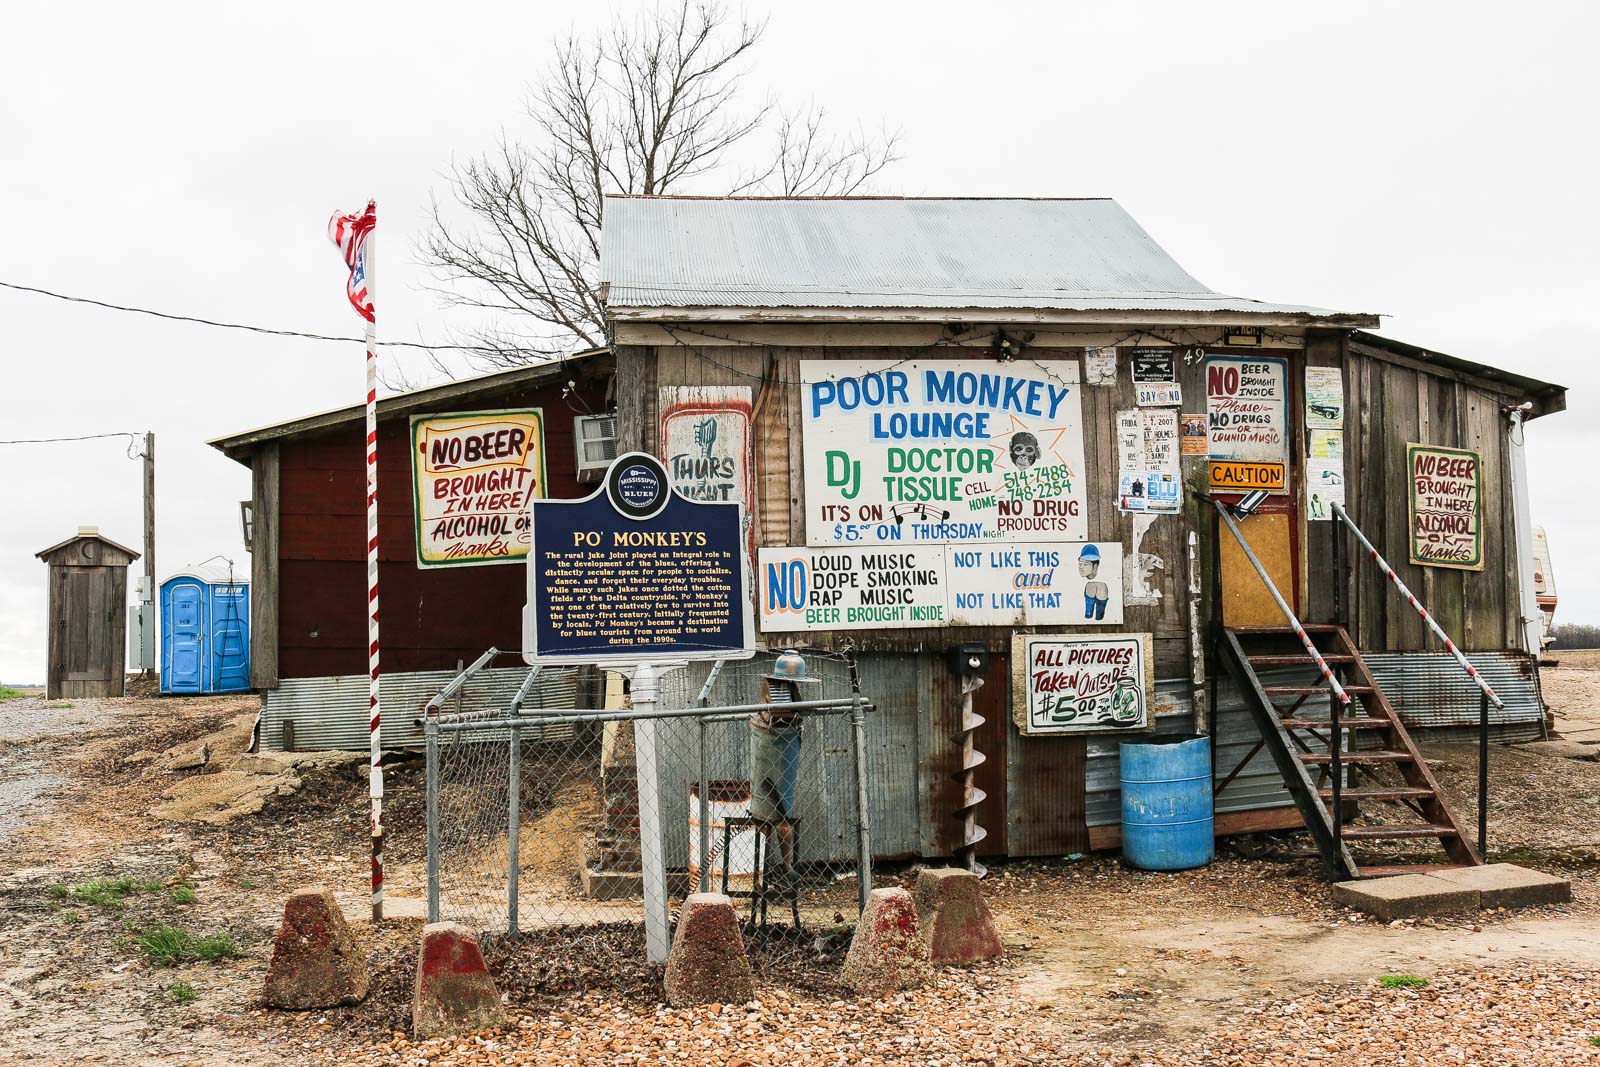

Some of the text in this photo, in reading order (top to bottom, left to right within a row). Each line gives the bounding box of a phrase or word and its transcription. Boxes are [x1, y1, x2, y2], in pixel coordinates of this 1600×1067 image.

[1184, 348, 1204, 365] 49
[1208, 364, 1270, 396] NO BEER
[1241, 377, 1275, 386] BROUGHT
[812, 371, 1069, 419] POOR MONKEY
[1141, 391, 1179, 402] SAY NO
[1239, 388, 1274, 396] INSIDE
[1216, 400, 1263, 413] Please
[874, 413, 990, 438] LOUNGE
[1210, 413, 1271, 426] NO DRUGS
[1247, 432, 1279, 443] MUSIC
[432, 429, 525, 464] NO BEER
[670, 454, 734, 480] THURS
[888, 448, 994, 473] DOCTOR
[1415, 455, 1475, 480] NO BEER
[826, 450, 861, 499] DJ
[965, 464, 1069, 495] CELL 514-7488
[1213, 467, 1279, 483] CAUTION
[434, 468, 532, 499] BROUGHT
[883, 477, 963, 501] TISSUE
[1416, 481, 1476, 498] BROUGHT
[443, 479, 536, 514] IN HERE!
[969, 480, 1071, 511] HOME 748-2254
[822, 505, 882, 522] IT'S ON
[998, 500, 1078, 516] NO DRUG
[1426, 497, 1477, 518] IN HERE!
[431, 515, 512, 542] ALCOHOL
[877, 524, 901, 540] ON
[912, 523, 983, 540] THURSDAY
[998, 518, 1067, 531] PRODUCTS
[1416, 515, 1476, 535] ALCOHOL
[444, 535, 509, 560] Thanks
[573, 532, 706, 546] PO' MONKEY'S
[1428, 534, 1454, 545] OK
[588, 552, 605, 560] juke
[609, 552, 628, 560] joint
[672, 551, 702, 559] integral
[954, 552, 1059, 568] NOT LIKE THIS
[1420, 543, 1471, 560] Thanks
[680, 560, 712, 568] offering
[811, 554, 916, 571] LOUD MUSIC
[544, 569, 584, 577] distinctly
[658, 568, 682, 576] people
[602, 577, 627, 585] forget
[814, 571, 938, 589] DOPE SMOKING
[1013, 569, 1053, 589] and
[546, 586, 569, 594] While
[618, 586, 638, 594] jukes
[766, 559, 808, 612] NO
[615, 602, 652, 610] relatively
[810, 589, 914, 606] RAP MUSIC
[956, 593, 1061, 609] NOT LIKE THAT
[567, 612, 617, 620] twenty-first
[654, 610, 685, 618] Initially
[688, 609, 729, 617] frequented
[647, 618, 675, 626] became
[806, 605, 943, 624] BEER BROUGHT INSIDE
[576, 629, 597, 637] blues
[1035, 648, 1133, 666] ALL PICTURES
